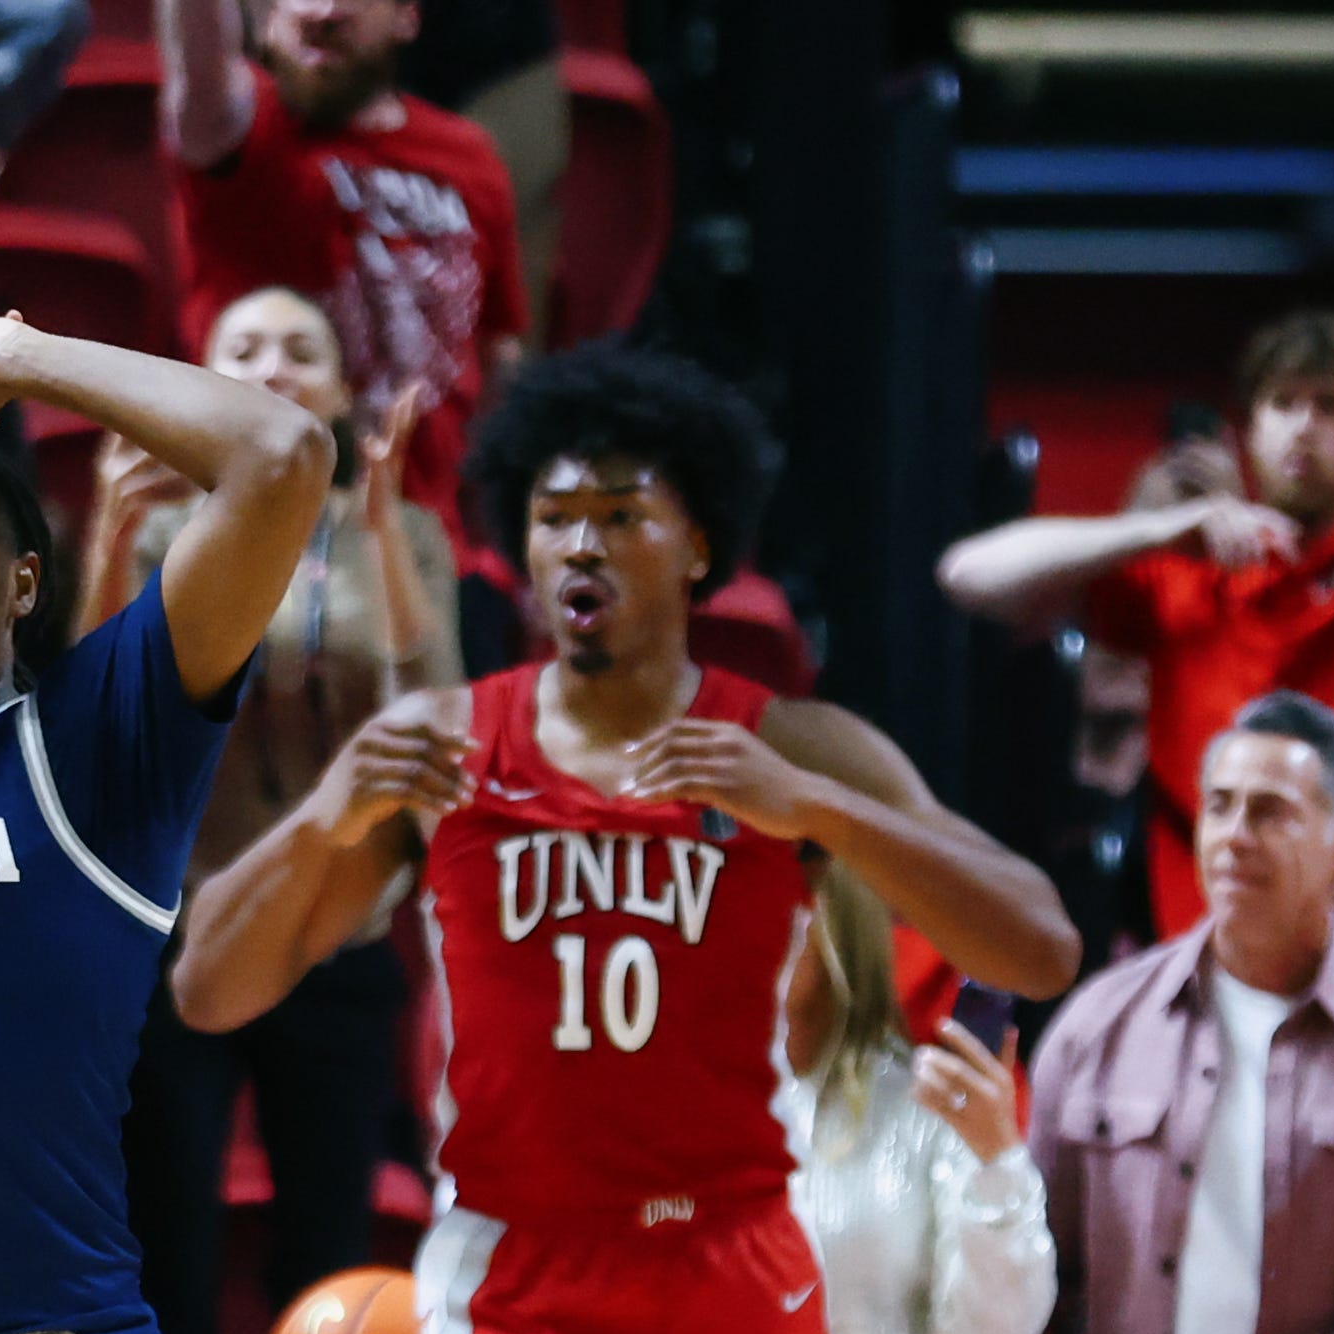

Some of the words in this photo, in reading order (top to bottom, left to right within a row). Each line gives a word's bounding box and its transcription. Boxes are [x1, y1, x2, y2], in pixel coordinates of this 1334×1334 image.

[494, 828, 726, 945] UNLV
[552, 933, 660, 1053] 10
[643, 1196, 695, 1228] UNLV
